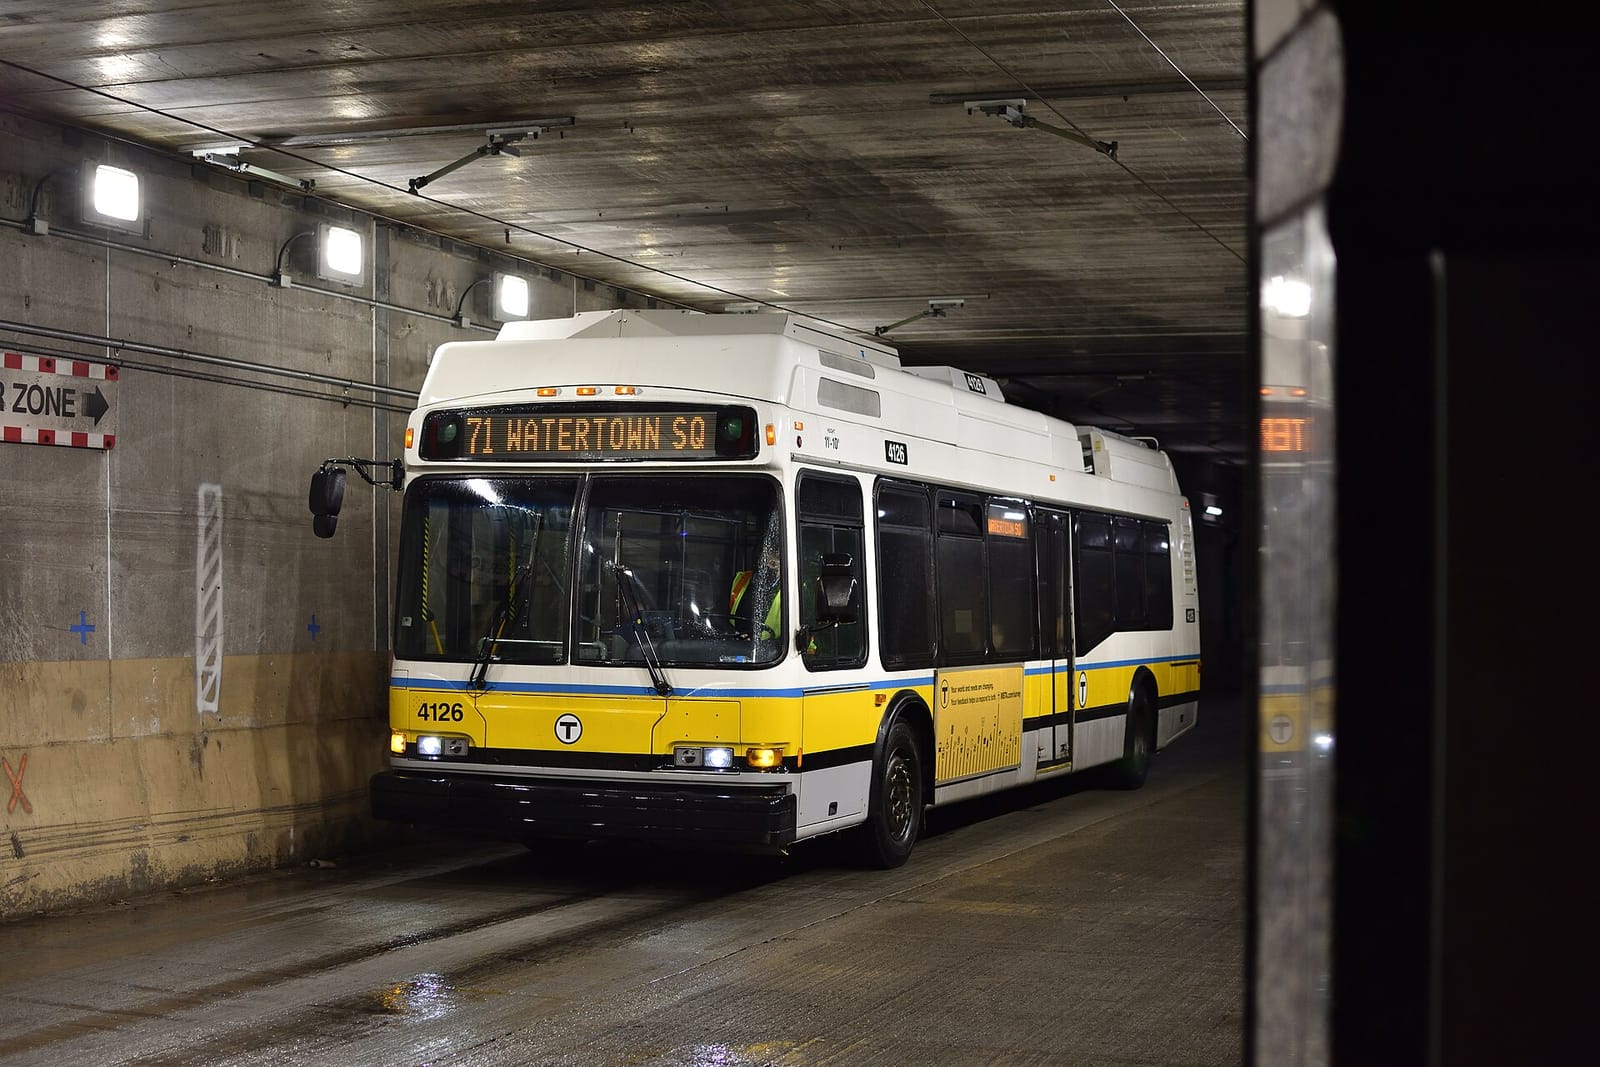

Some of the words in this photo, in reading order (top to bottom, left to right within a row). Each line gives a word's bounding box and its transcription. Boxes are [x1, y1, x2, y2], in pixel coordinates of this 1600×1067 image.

[12, 383, 76, 418] ZONE
[466, 418, 494, 453] 71
[507, 417, 661, 451] WATERTOWN
[672, 416, 706, 449] SQ
[888, 445, 905, 463] 4126
[417, 703, 464, 722] 4126
